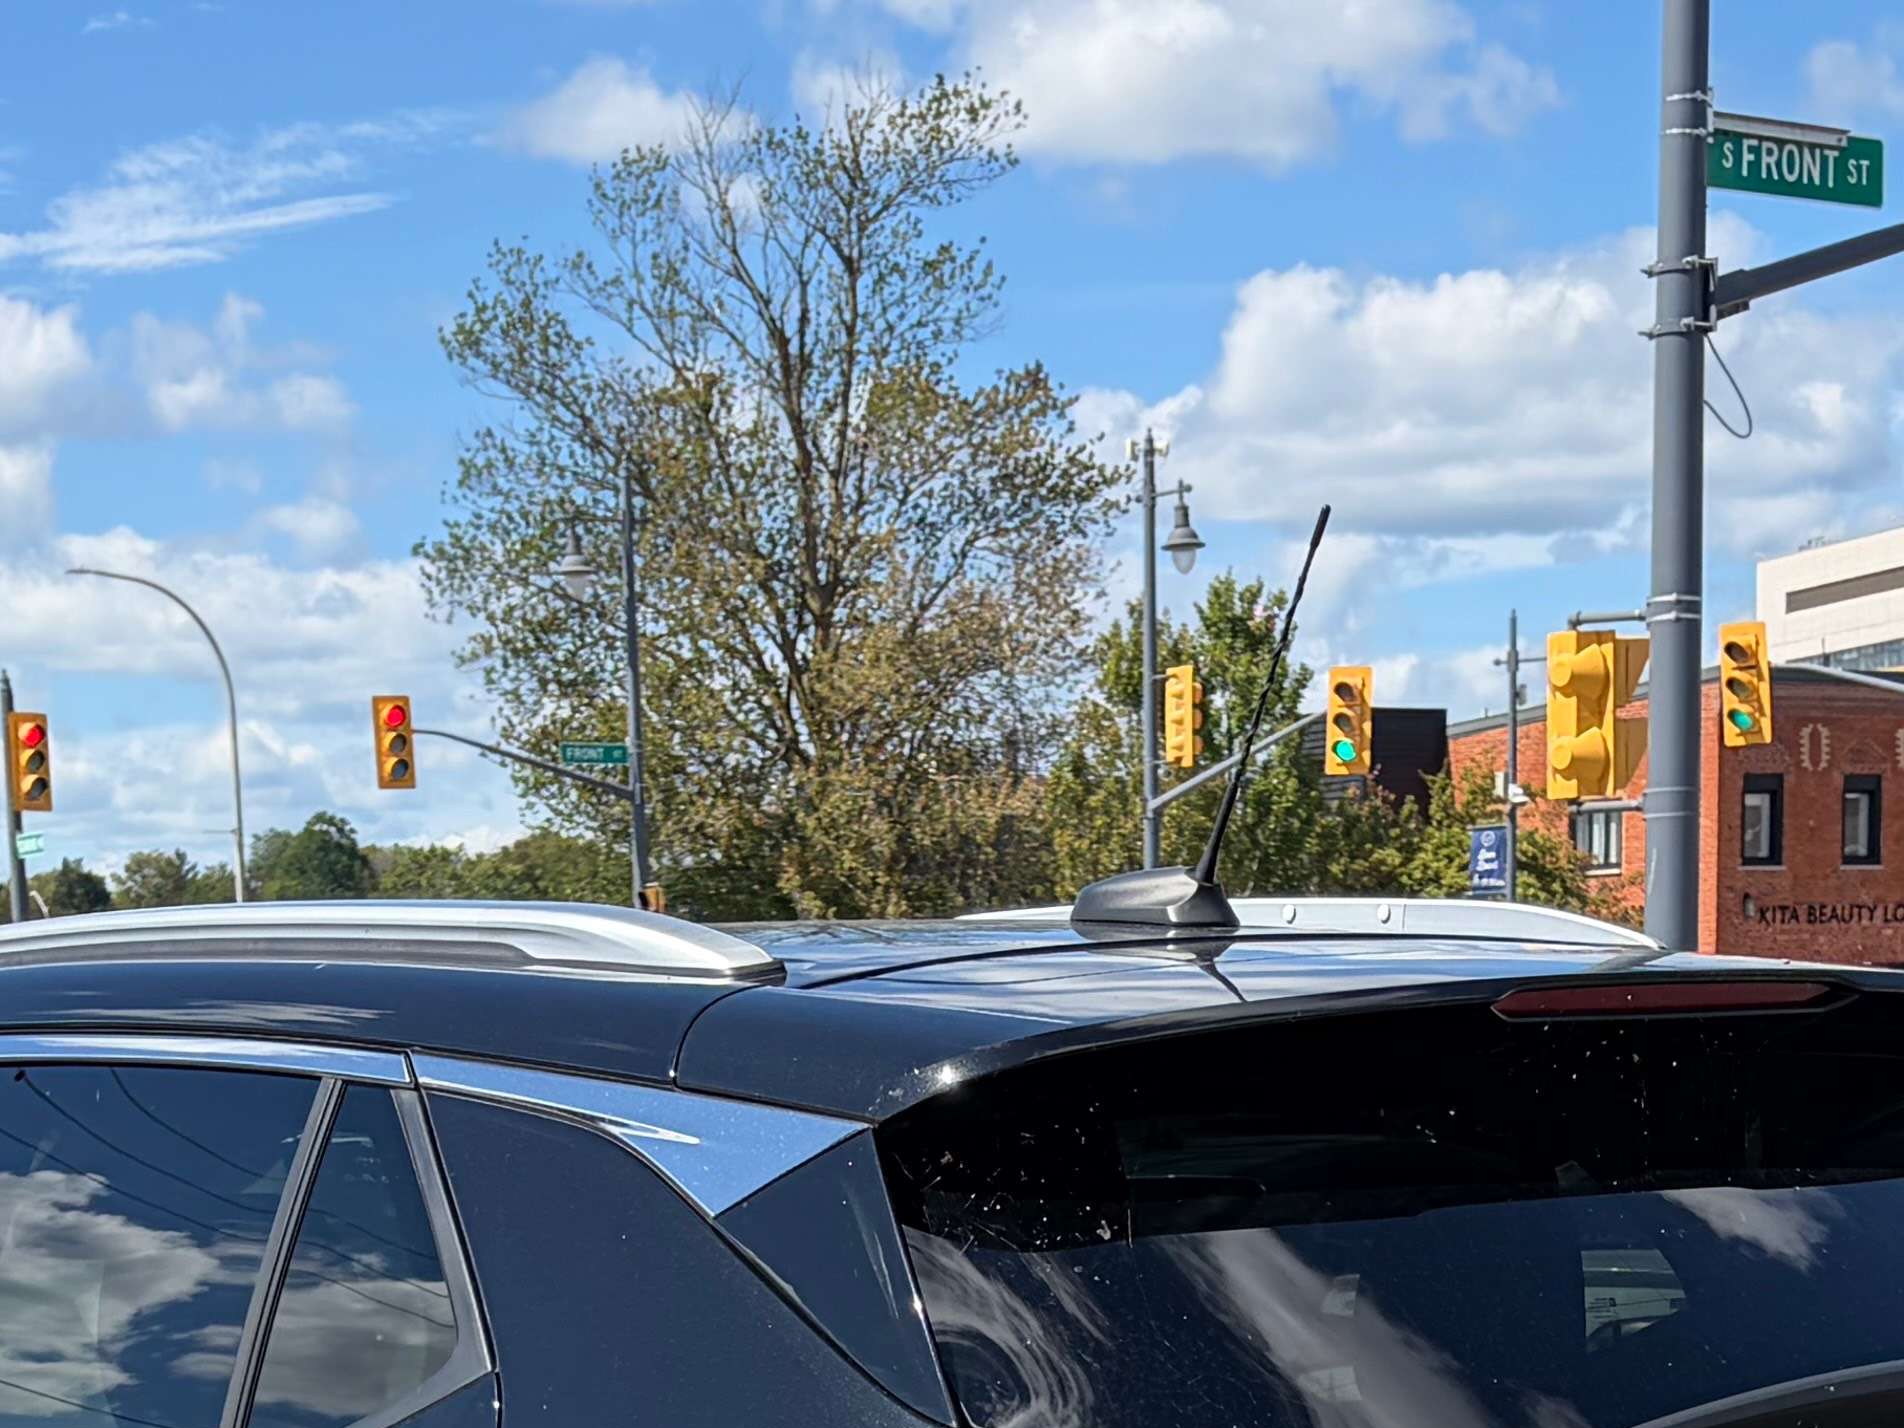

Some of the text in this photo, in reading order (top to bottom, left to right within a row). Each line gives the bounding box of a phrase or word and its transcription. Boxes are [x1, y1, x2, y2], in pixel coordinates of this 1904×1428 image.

[1721, 138, 1871, 189] S FRONT ST
[1758, 905, 1800, 926] KITA
[1807, 903, 1877, 925] BEAUTY
